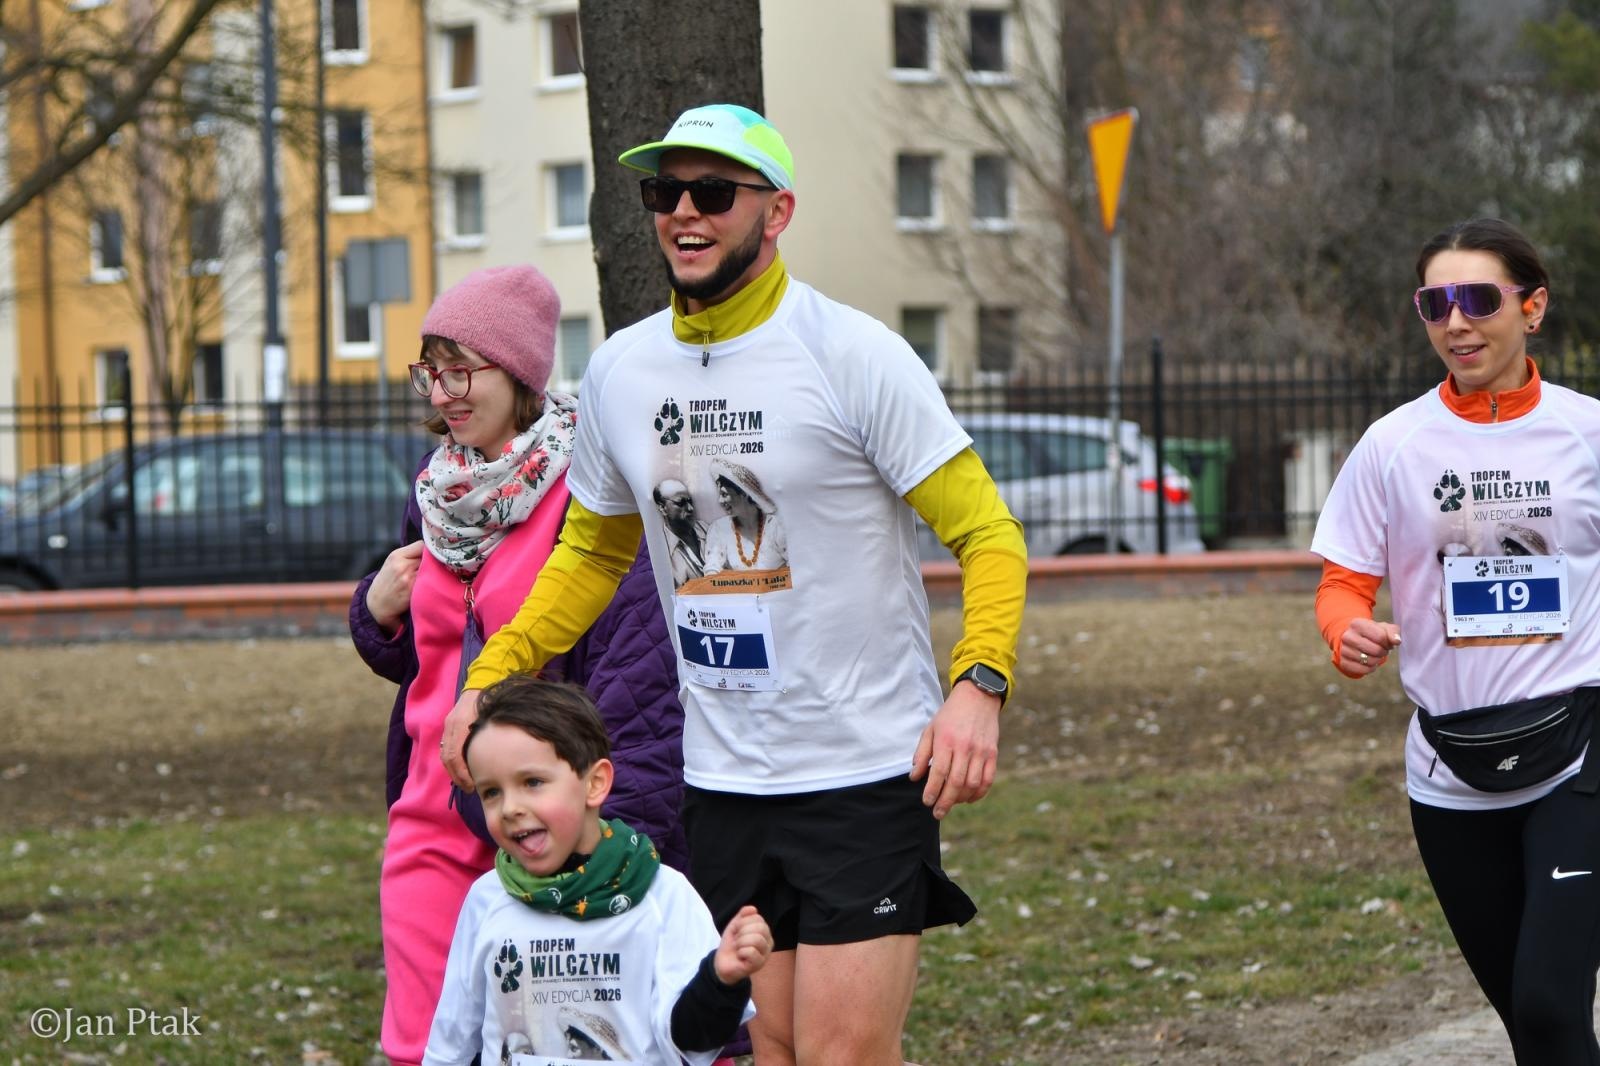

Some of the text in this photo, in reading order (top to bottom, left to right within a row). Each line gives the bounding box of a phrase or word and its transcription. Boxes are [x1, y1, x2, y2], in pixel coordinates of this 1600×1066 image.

[678, 120, 714, 128] KIPRUN
[689, 399, 727, 412] TROPEM
[690, 411, 763, 434] WILCZYM
[690, 442, 764, 457] XIV EDYCJA 2026
[1470, 470, 1511, 482] TROPEM
[1472, 480, 1551, 501] WILCZYM
[1473, 506, 1552, 521] XIV EDYCJA 2026
[1494, 564, 1533, 575] WILCZYM
[1488, 581, 1530, 611] 19
[1546, 611, 1561, 619] 2026
[700, 618, 736, 629] WILCZYM
[700, 635, 735, 666] 17
[529, 938, 576, 953] TROPEM
[530, 953, 620, 978] WILCZYM
[531, 988, 622, 1005] XIV EDYCJA 2026
